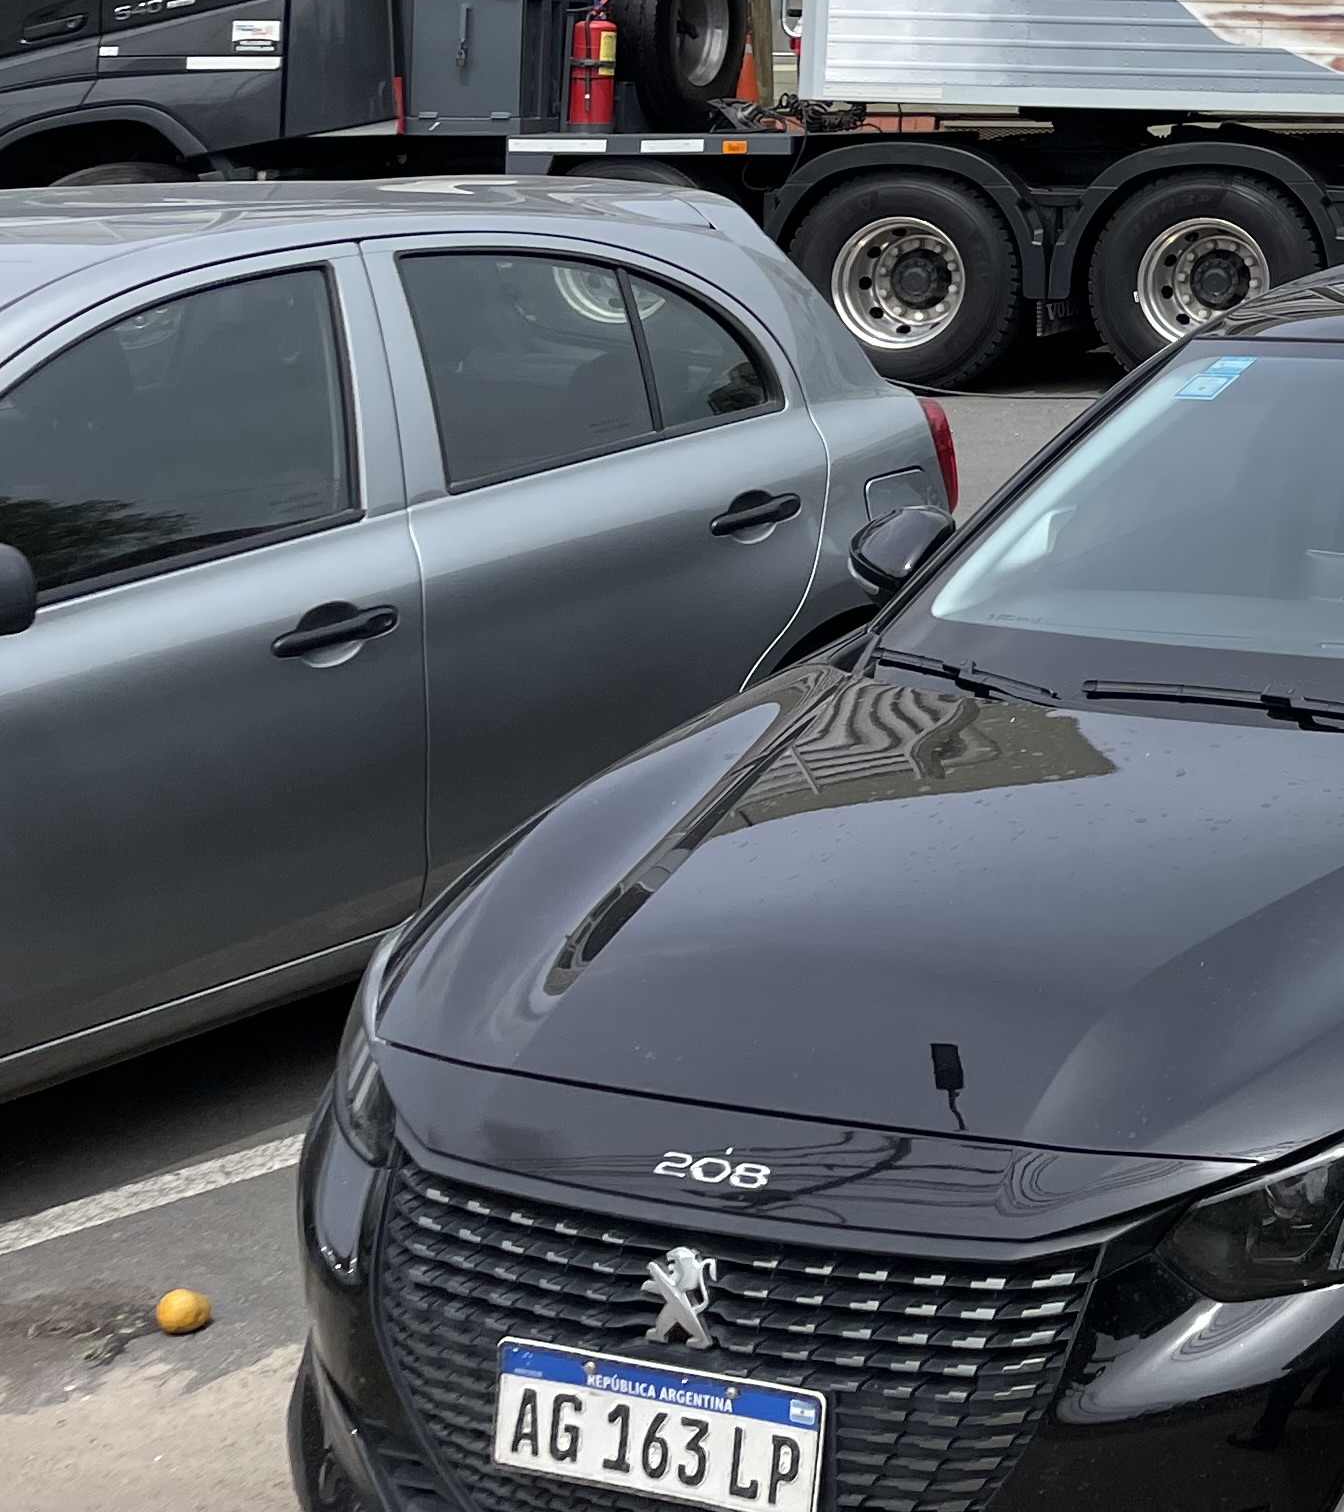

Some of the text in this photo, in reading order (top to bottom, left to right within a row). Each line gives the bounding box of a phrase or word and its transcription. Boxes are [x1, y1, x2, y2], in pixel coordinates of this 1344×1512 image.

[652, 1150, 772, 1189] 208
[586, 1373, 734, 1414] REPÚBLICA ARGENTINA
[510, 1387, 802, 1506] AG 163 LP
